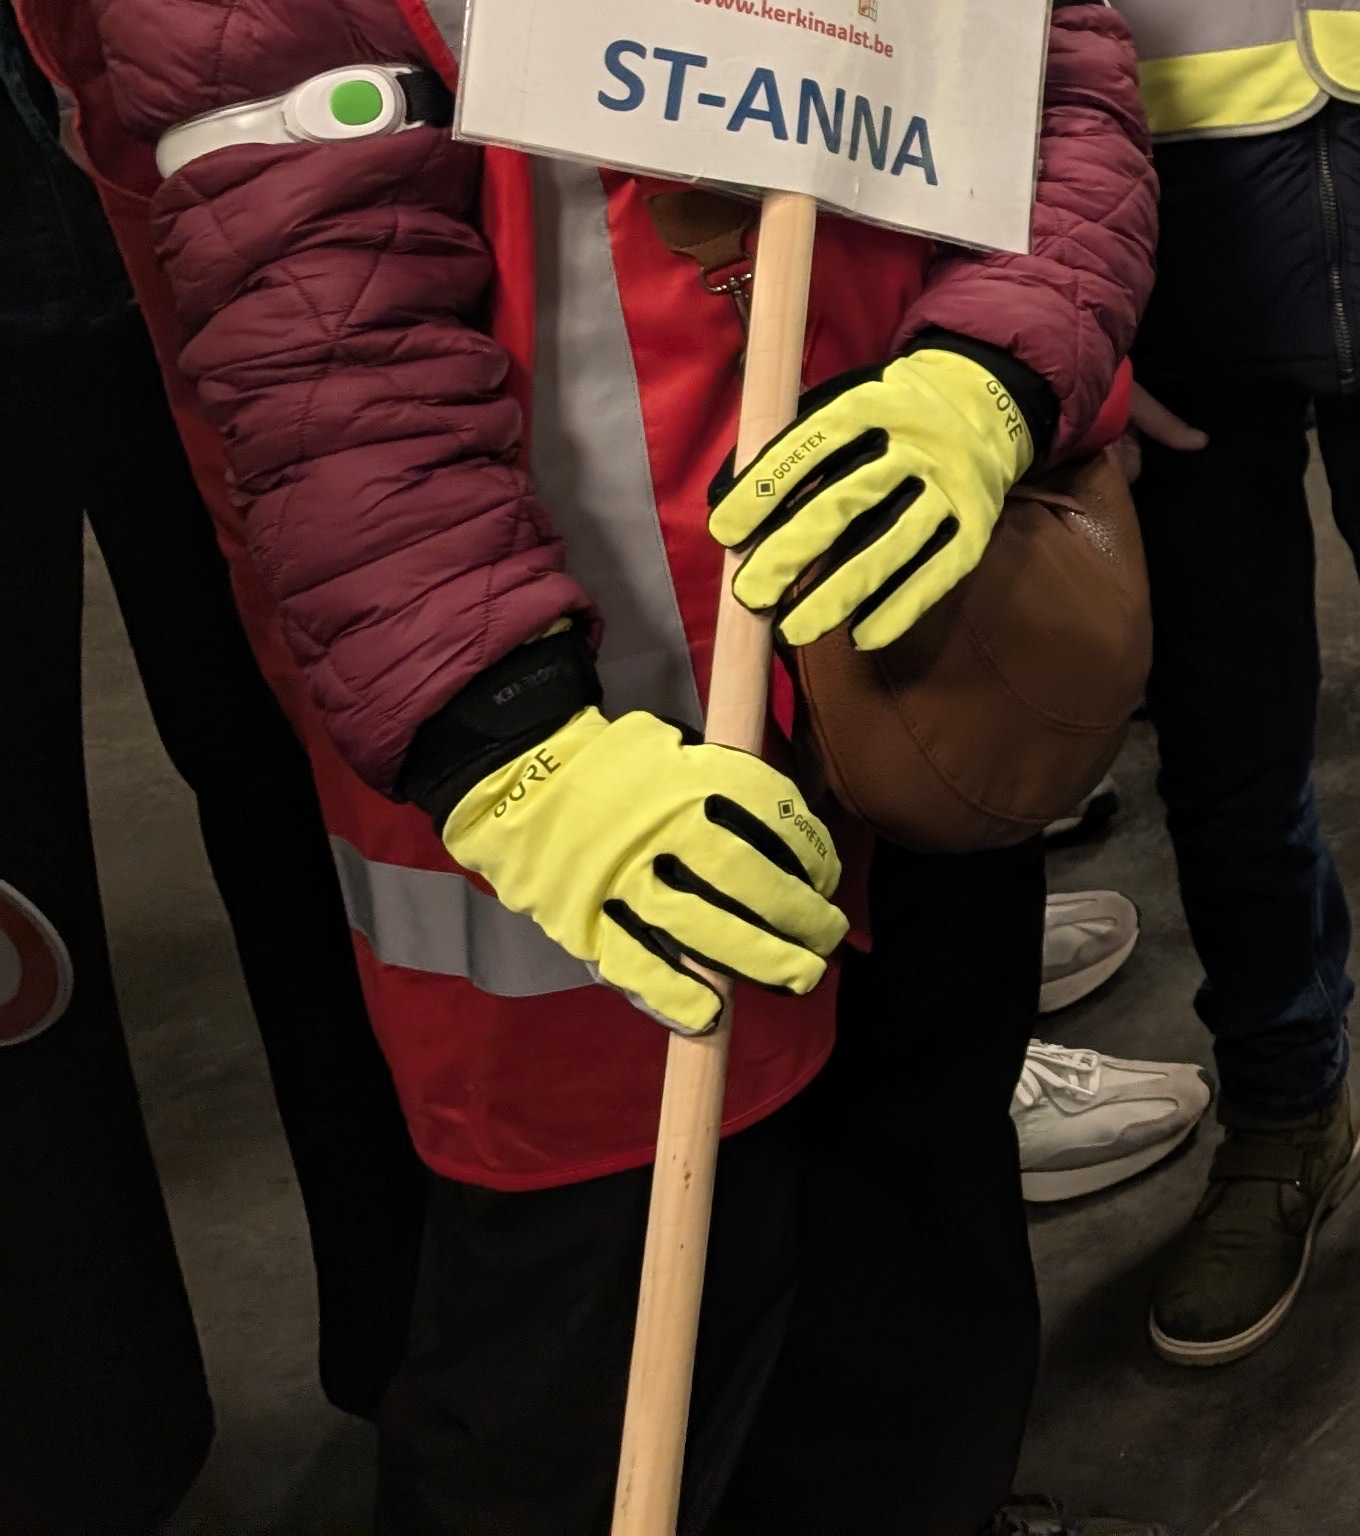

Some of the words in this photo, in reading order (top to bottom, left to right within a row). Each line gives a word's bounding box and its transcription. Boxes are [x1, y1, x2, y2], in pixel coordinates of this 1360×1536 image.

[597, 39, 939, 187] ST-ANNA
[986, 379, 1023, 442] GORE
[773, 431, 827, 480] GORE-TEX
